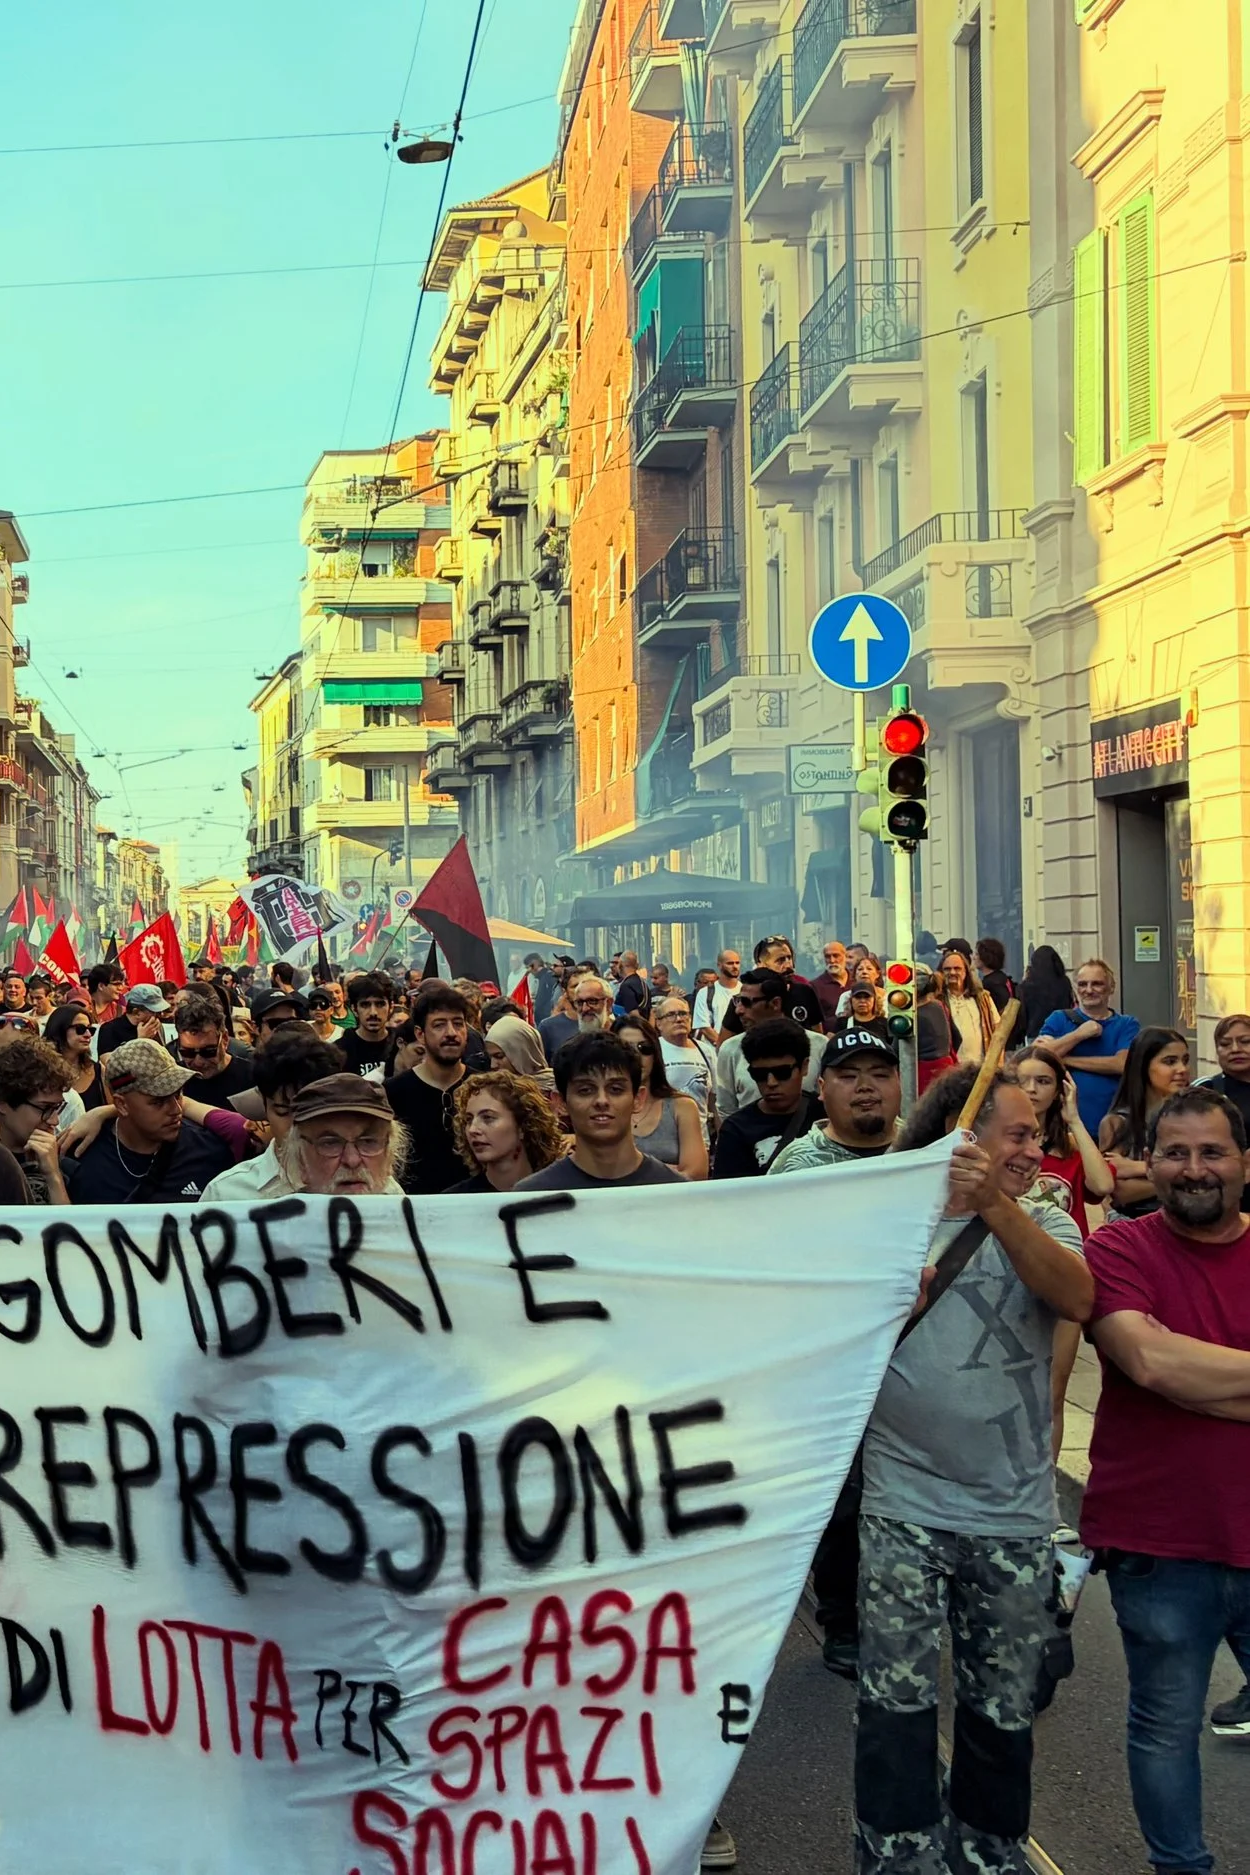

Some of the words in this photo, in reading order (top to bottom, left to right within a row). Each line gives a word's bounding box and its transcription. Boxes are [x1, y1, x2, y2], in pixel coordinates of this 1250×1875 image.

[837, 1031, 887, 1050] ICON
[498, 1193, 610, 1322] E
[92, 1604, 298, 1762] LOTTA
[314, 1668, 410, 1766] PER
[442, 1589, 698, 1696] CASA
[428, 1704, 661, 1799] SPAZI
[716, 1682, 751, 1745] E
